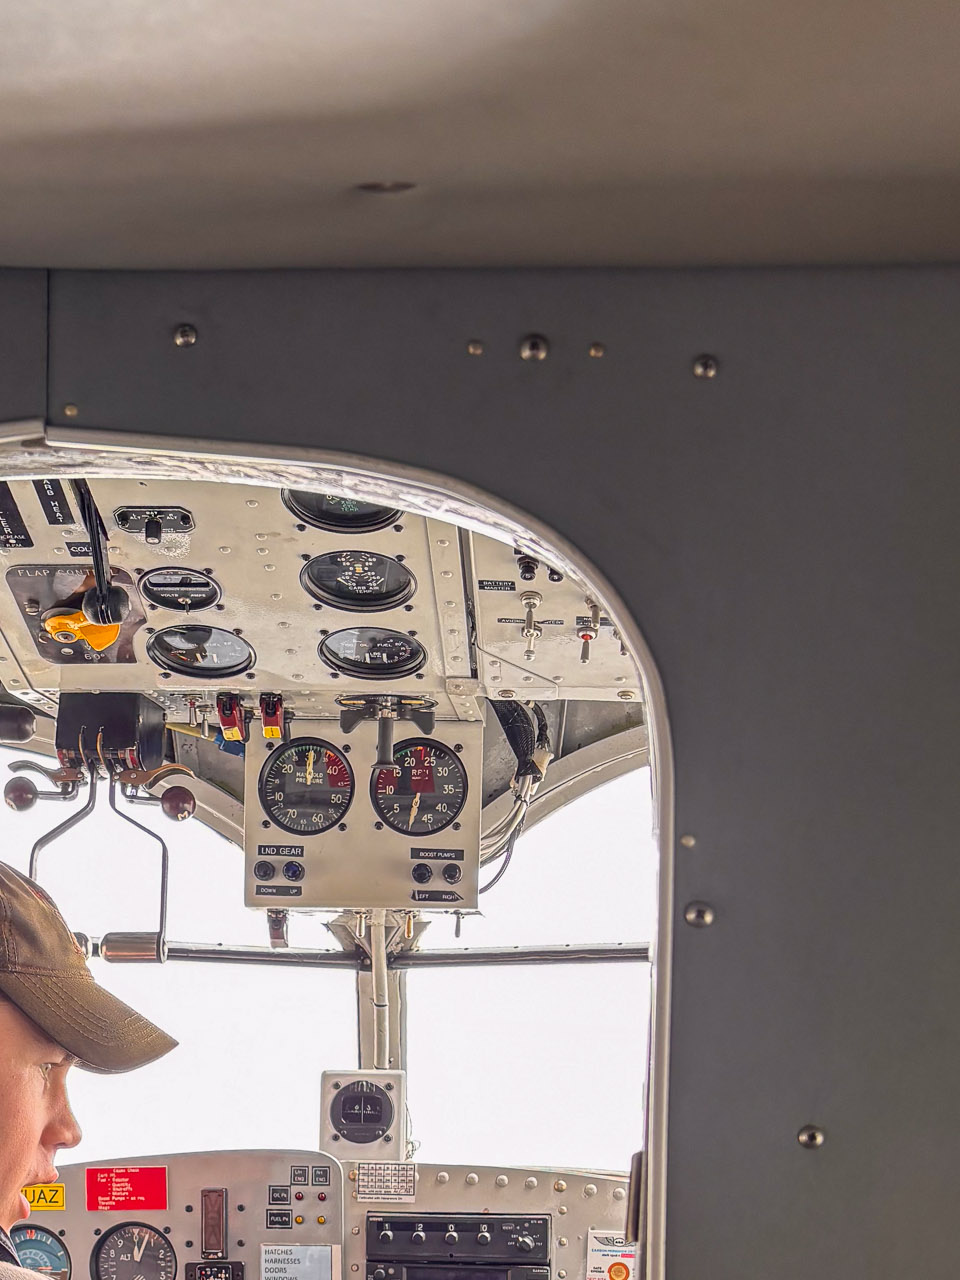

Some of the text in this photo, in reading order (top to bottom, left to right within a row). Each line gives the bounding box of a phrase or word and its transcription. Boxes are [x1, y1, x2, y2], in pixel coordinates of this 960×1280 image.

[404, 758, 416, 766] 20
[424, 757, 436, 766] 25
[282, 764, 294, 774] 20
[327, 766, 338, 775] 40
[393, 768, 402, 777] 15
[437, 767, 448, 776] 30
[386, 786, 394, 794] 10
[442, 785, 454, 794] 35
[275, 792, 284, 800] 10
[330, 794, 342, 804] 50
[394, 804, 400, 812] 5
[436, 804, 448, 812] 40
[287, 809, 297, 818] 70
[312, 814, 323, 822] 60
[422, 814, 433, 823] 45
[22, 1189, 59, 1204] UAZ
[118, 1240, 123, 1248] 9
[159, 1250, 164, 1258] 2
[160, 1272, 165, 1280] 3
